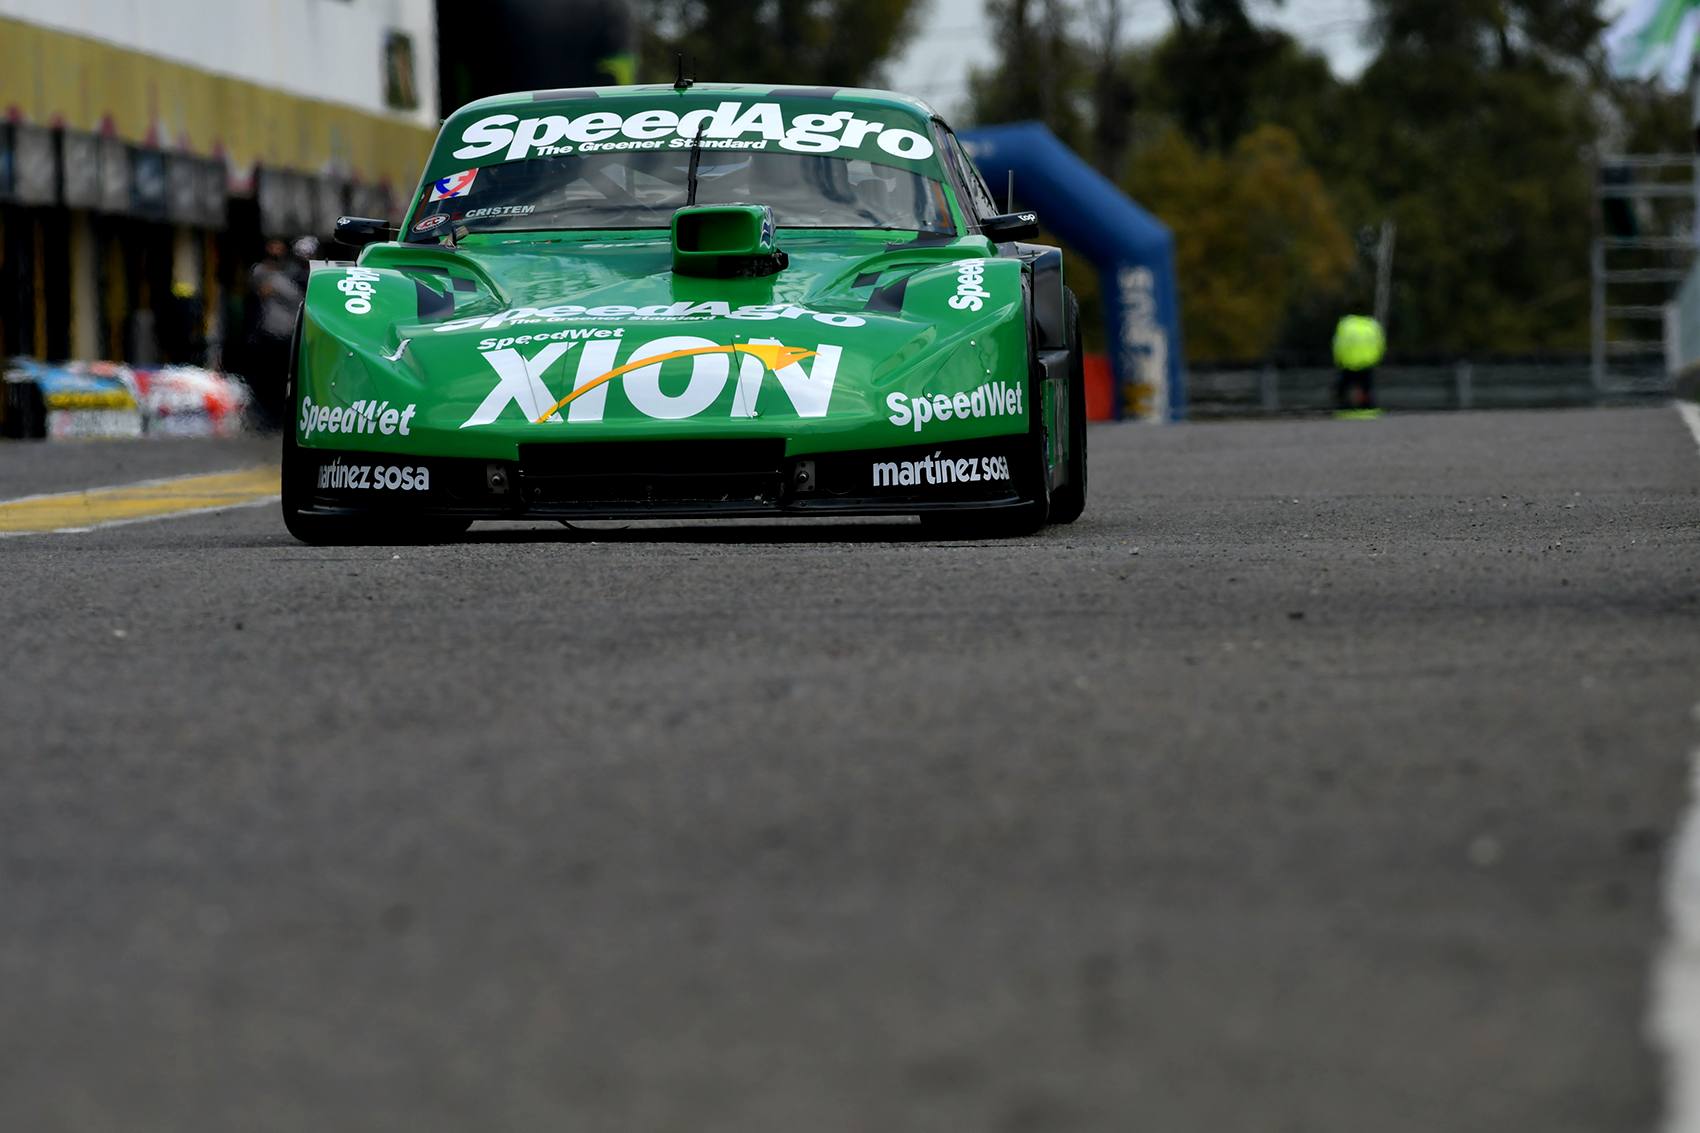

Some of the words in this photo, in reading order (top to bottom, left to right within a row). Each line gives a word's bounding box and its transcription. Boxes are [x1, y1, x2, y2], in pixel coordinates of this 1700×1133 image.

[453, 102, 934, 160] SpeedAgro
[537, 145, 572, 157] The
[578, 139, 664, 152] Greener
[465, 205, 536, 218] CRISTEM
[433, 301, 867, 332] SpeedAgro
[477, 328, 624, 351] SpeedWet
[459, 335, 843, 429] XION
[300, 395, 416, 439] SpeedWet
[886, 381, 1022, 432] SpeedWet
[373, 466, 430, 490] sosa
[873, 451, 981, 486] martínez
[981, 456, 1010, 481] sosa
